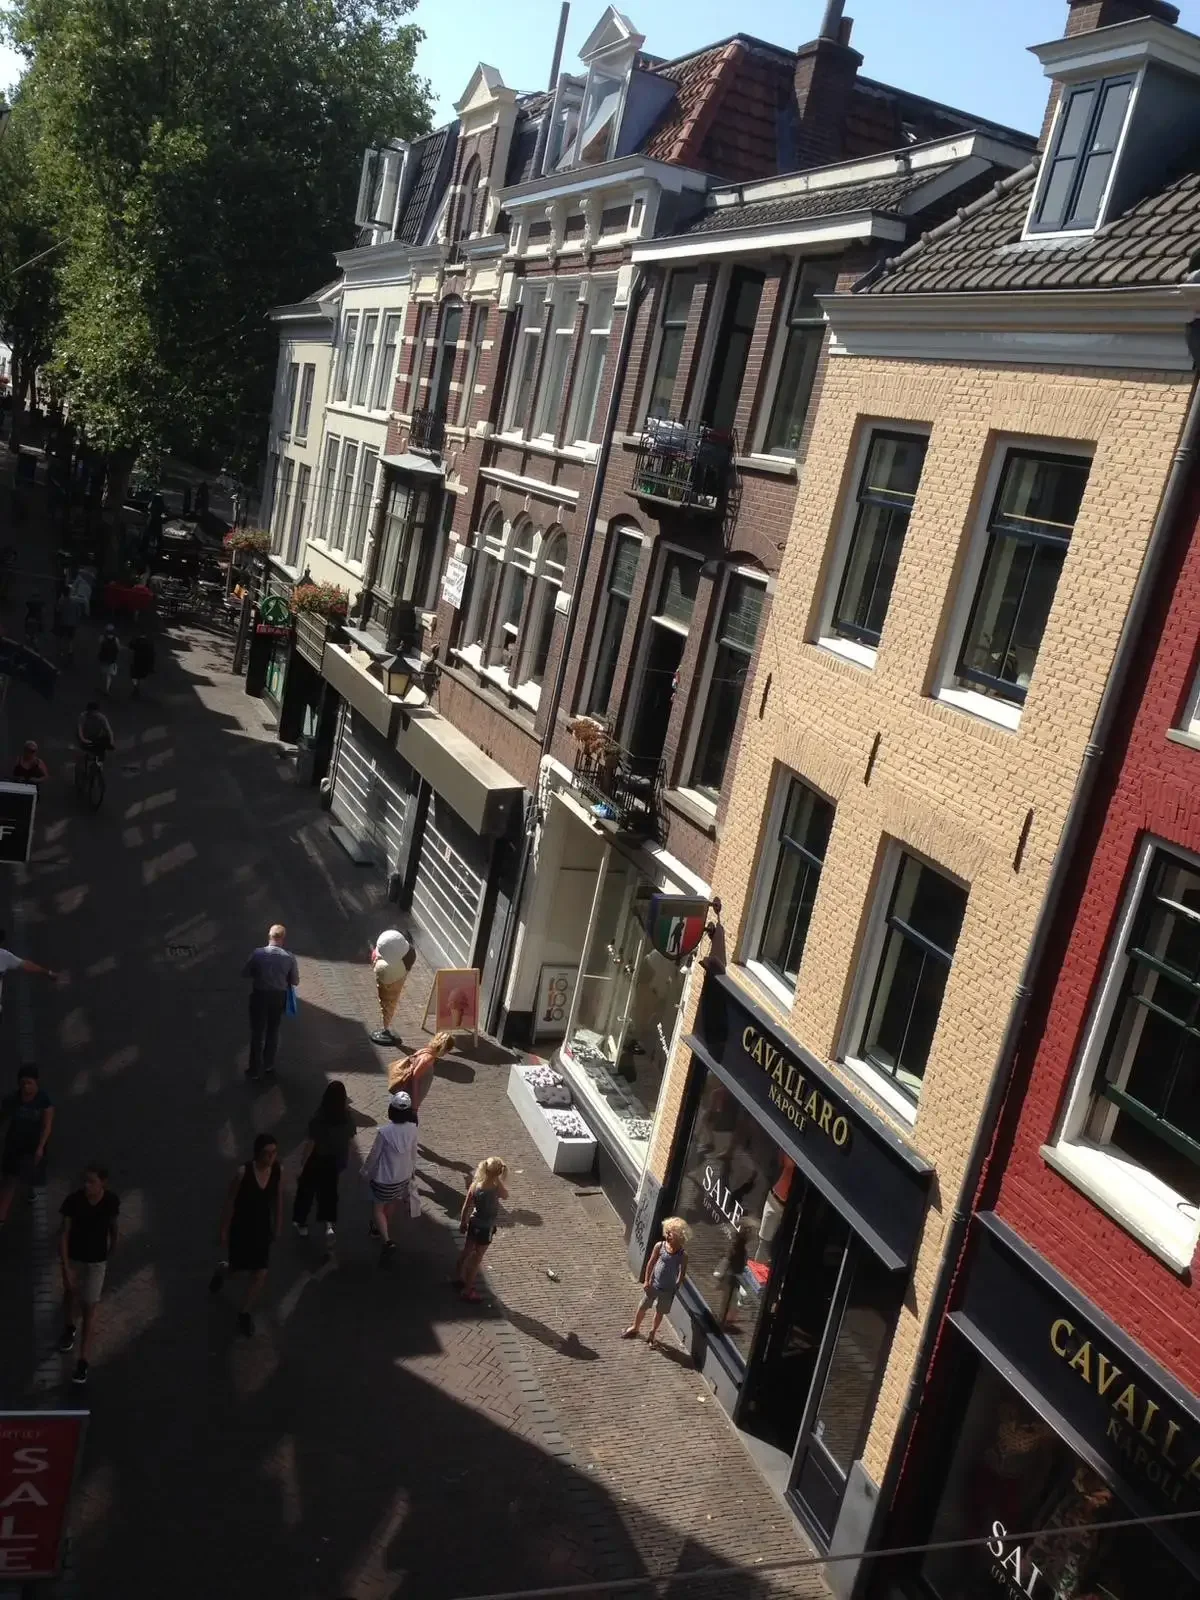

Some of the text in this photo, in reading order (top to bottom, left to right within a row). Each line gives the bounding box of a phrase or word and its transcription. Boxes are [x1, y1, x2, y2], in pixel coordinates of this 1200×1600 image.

[742, 1026, 850, 1146] CAVALLARO
[768, 1084, 806, 1131] NAPOLI
[702, 1165, 744, 1232] SALE
[1106, 1415, 1184, 1504] NAPOLI
[0, 1447, 50, 1571] SALE
